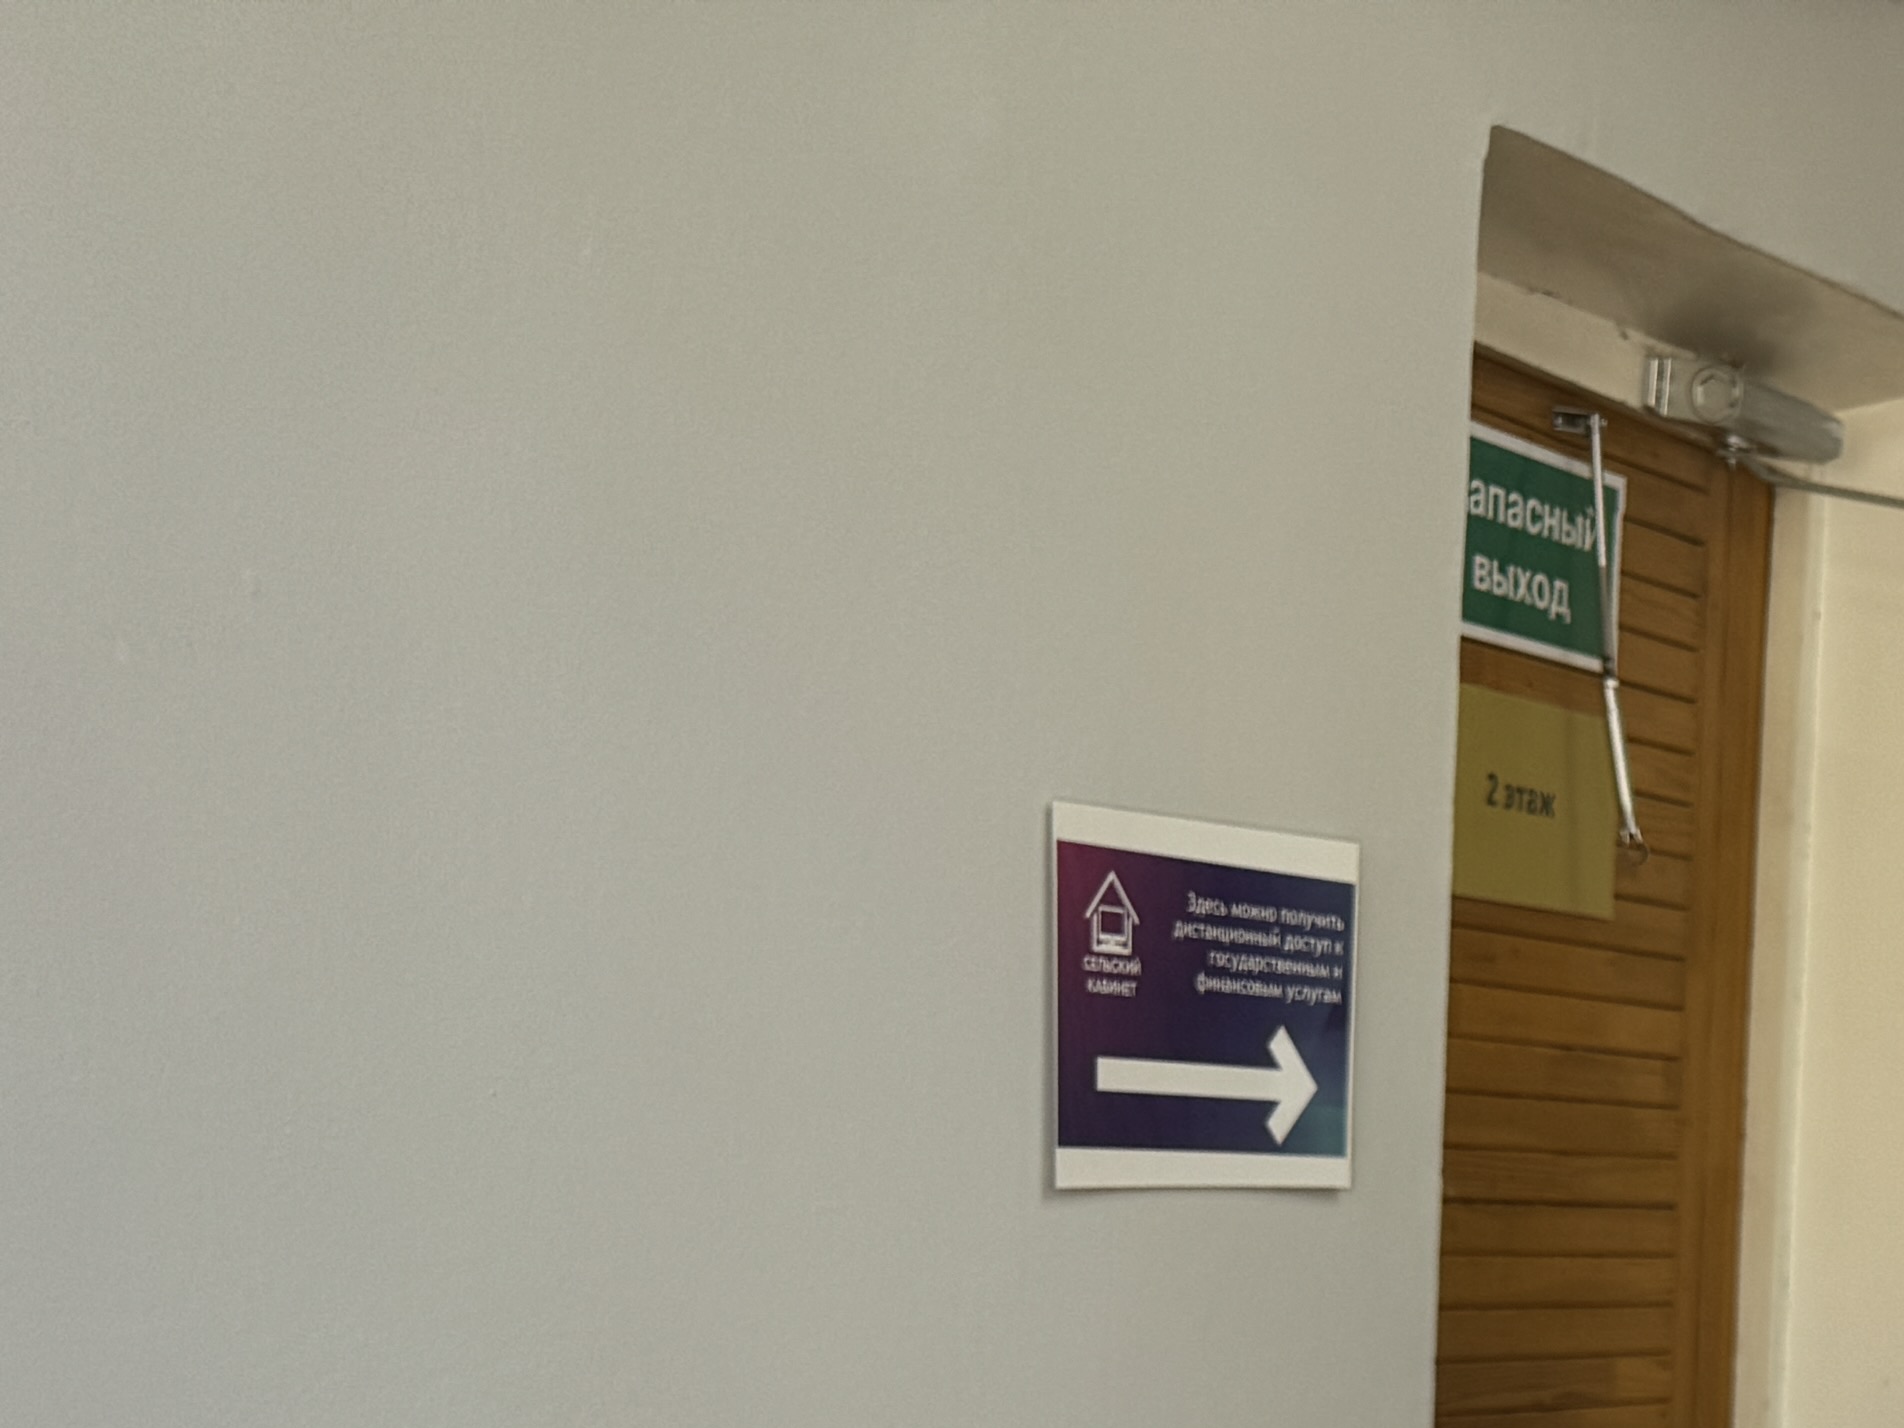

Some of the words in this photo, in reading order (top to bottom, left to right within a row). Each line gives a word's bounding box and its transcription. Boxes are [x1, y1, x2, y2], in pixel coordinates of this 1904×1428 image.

[1487, 771, 1498, 807] 2
[1503, 784, 1556, 818] этаж
[1187, 891, 1228, 917] Здесь
[1231, 902, 1278, 922] можно
[1280, 908, 1345, 931] получить
[1173, 920, 1281, 947] дистанционный
[1284, 934, 1332, 957] доступ
[1084, 954, 1141, 976] СЕЛЬСКИЙ
[1209, 951, 1330, 979] государственным
[1087, 979, 1137, 998] КАБИНЕТ
[1196, 971, 1283, 998] финансовым
[1286, 985, 1342, 1005] услугам
